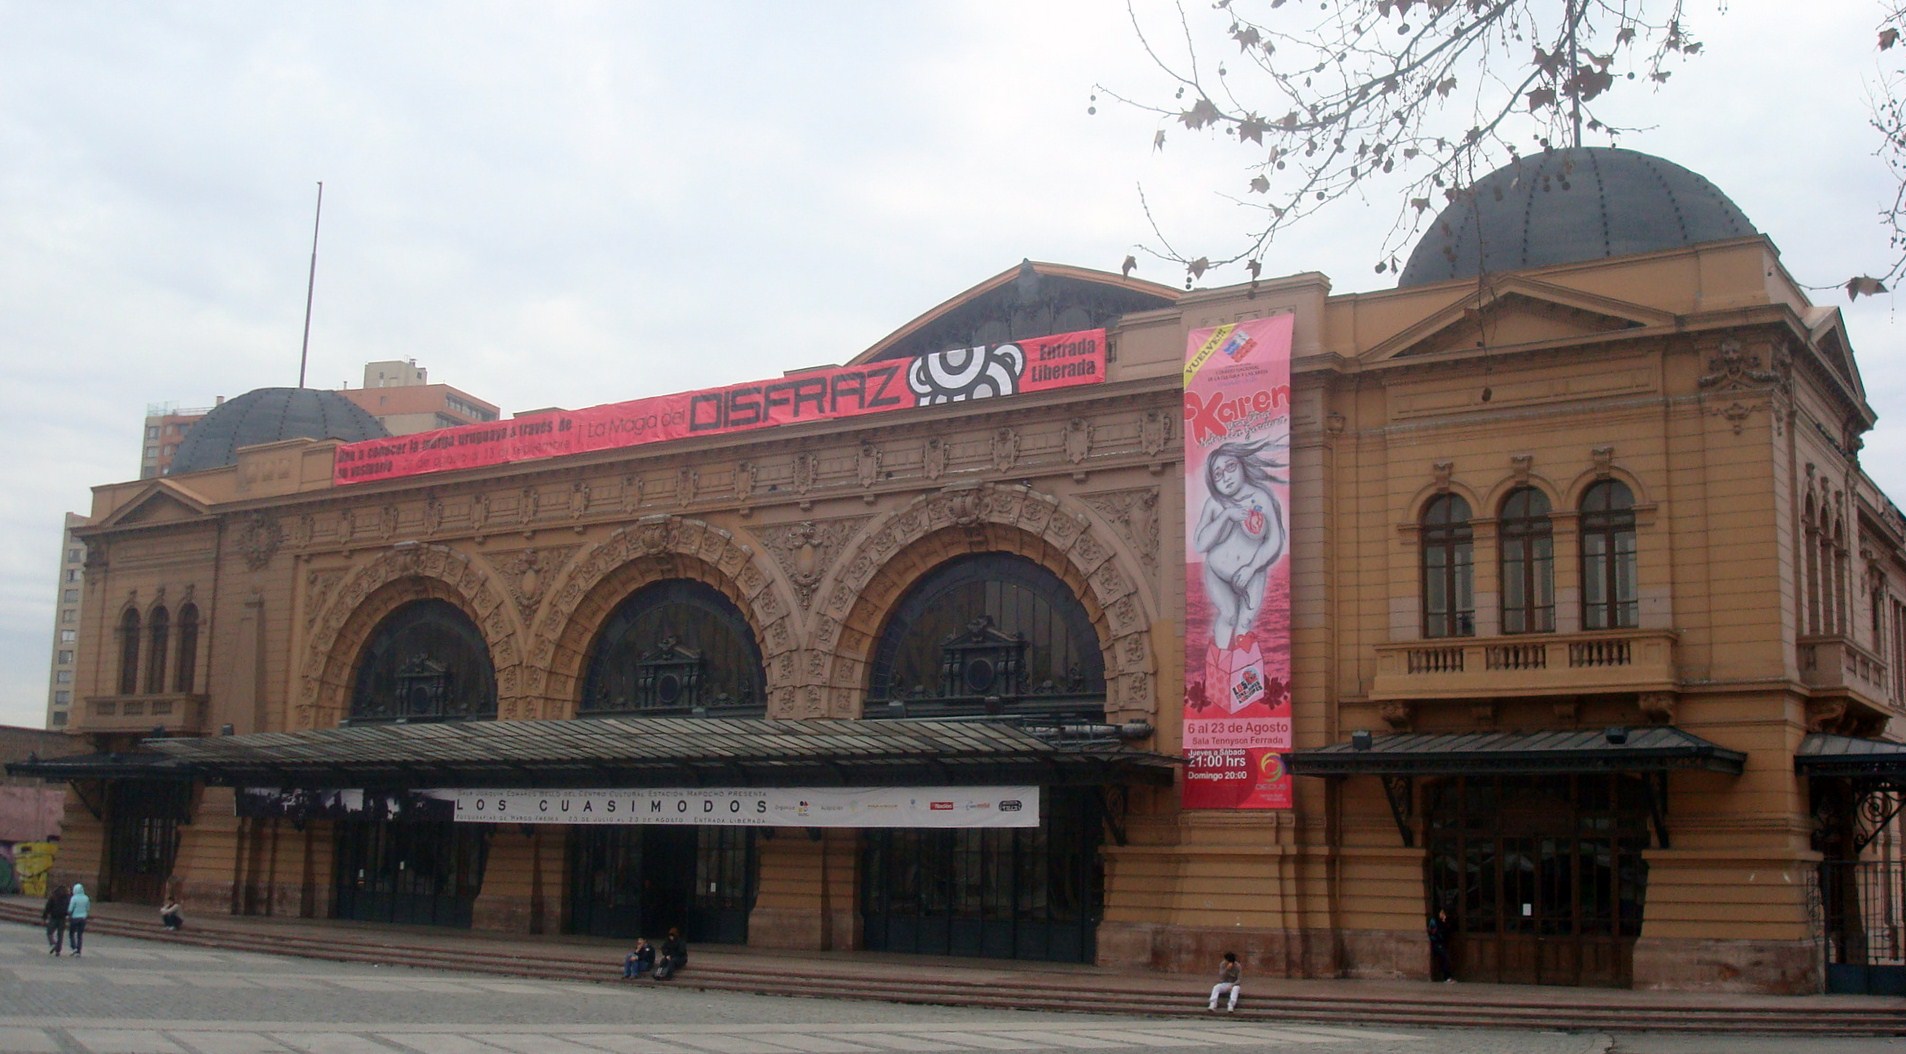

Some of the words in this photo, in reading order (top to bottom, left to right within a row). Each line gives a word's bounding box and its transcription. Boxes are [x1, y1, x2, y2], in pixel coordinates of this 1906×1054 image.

[1040, 338, 1096, 361] Entrada
[1032, 359, 1096, 383] Liberada
[588, 421, 605, 438] La
[608, 415, 657, 436] Maga
[662, 410, 686, 428] del
[690, 365, 901, 432] DISFRAZ
[1184, 385, 1290, 444] Karen
[368, 442, 406, 459] conocer
[410, 438, 418, 454] la
[458, 426, 507, 446] uruguaya
[520, 418, 553, 437] través
[559, 416, 572, 432] de
[351, 460, 393, 477] vestuario
[1188, 723, 1195, 734] 6
[1198, 722, 1208, 734] al
[1211, 722, 1224, 734] 23
[1228, 722, 1242, 733] de
[1245, 721, 1289, 735] Agosto
[1192, 737, 1209, 745] Sala
[1212, 736, 1247, 746] Tennyson
[1250, 736, 1283, 745] Ferrada
[1188, 750, 1212, 758] Jueves
[1219, 748, 1246, 756] Sábado
[1188, 755, 1223, 767] 21:00
[1226, 755, 1246, 767] hrs
[1188, 771, 1223, 782] Domingo
[1224, 771, 1247, 780] 20:00
[456, 799, 506, 811] LOS
[539, 799, 767, 813] CUASIMODOS
